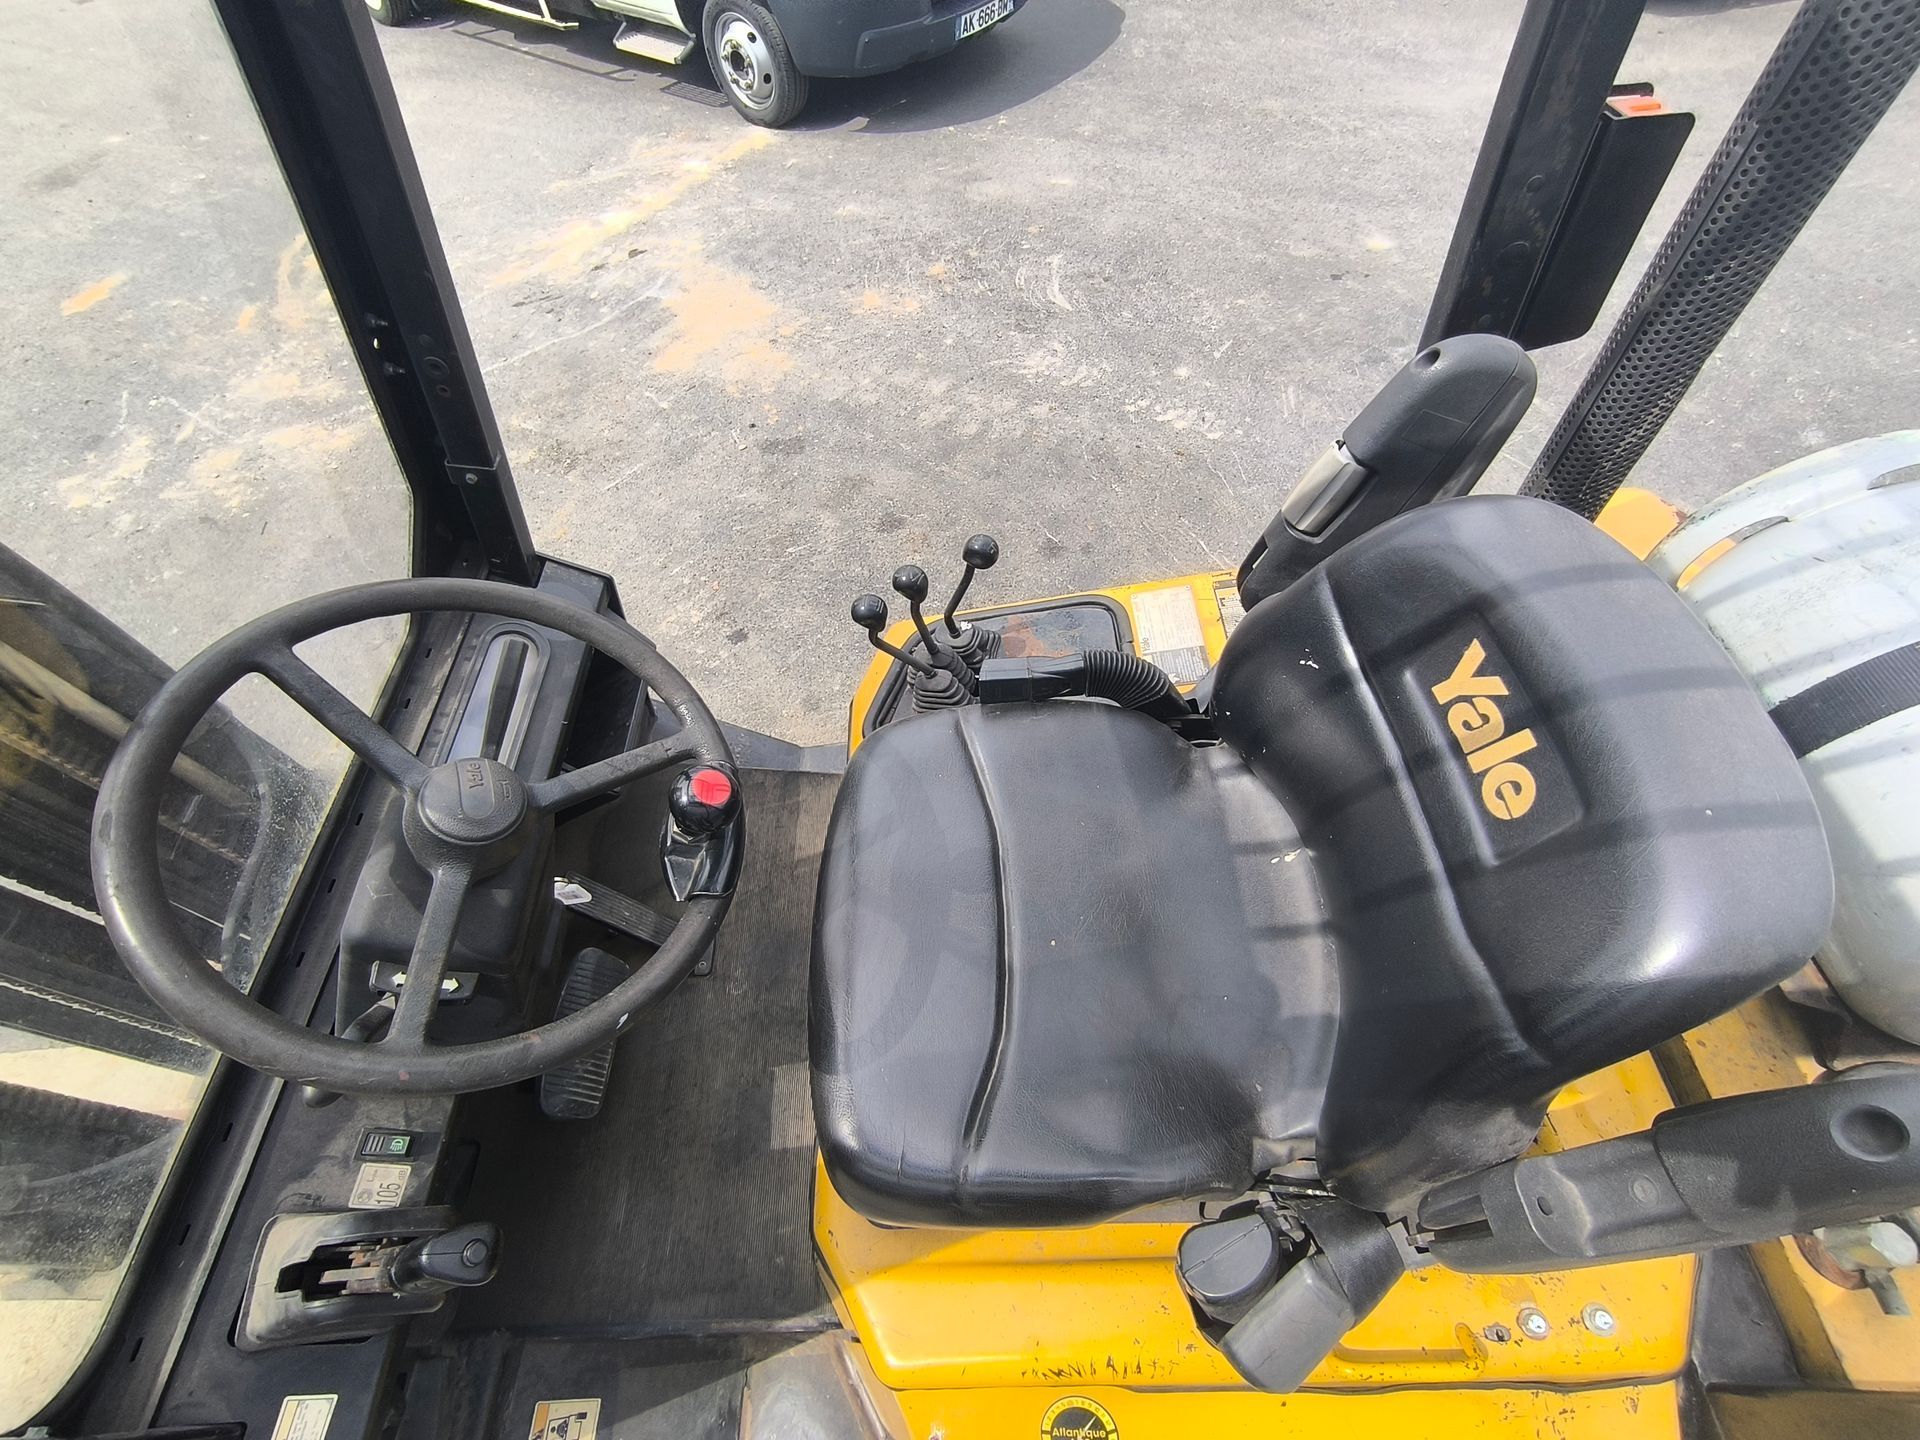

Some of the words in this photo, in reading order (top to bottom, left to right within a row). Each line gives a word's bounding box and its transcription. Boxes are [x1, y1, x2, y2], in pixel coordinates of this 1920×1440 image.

[1431, 638, 1538, 821] Yale
[465, 763, 484, 789] Yale
[374, 1182, 401, 1205] 105
